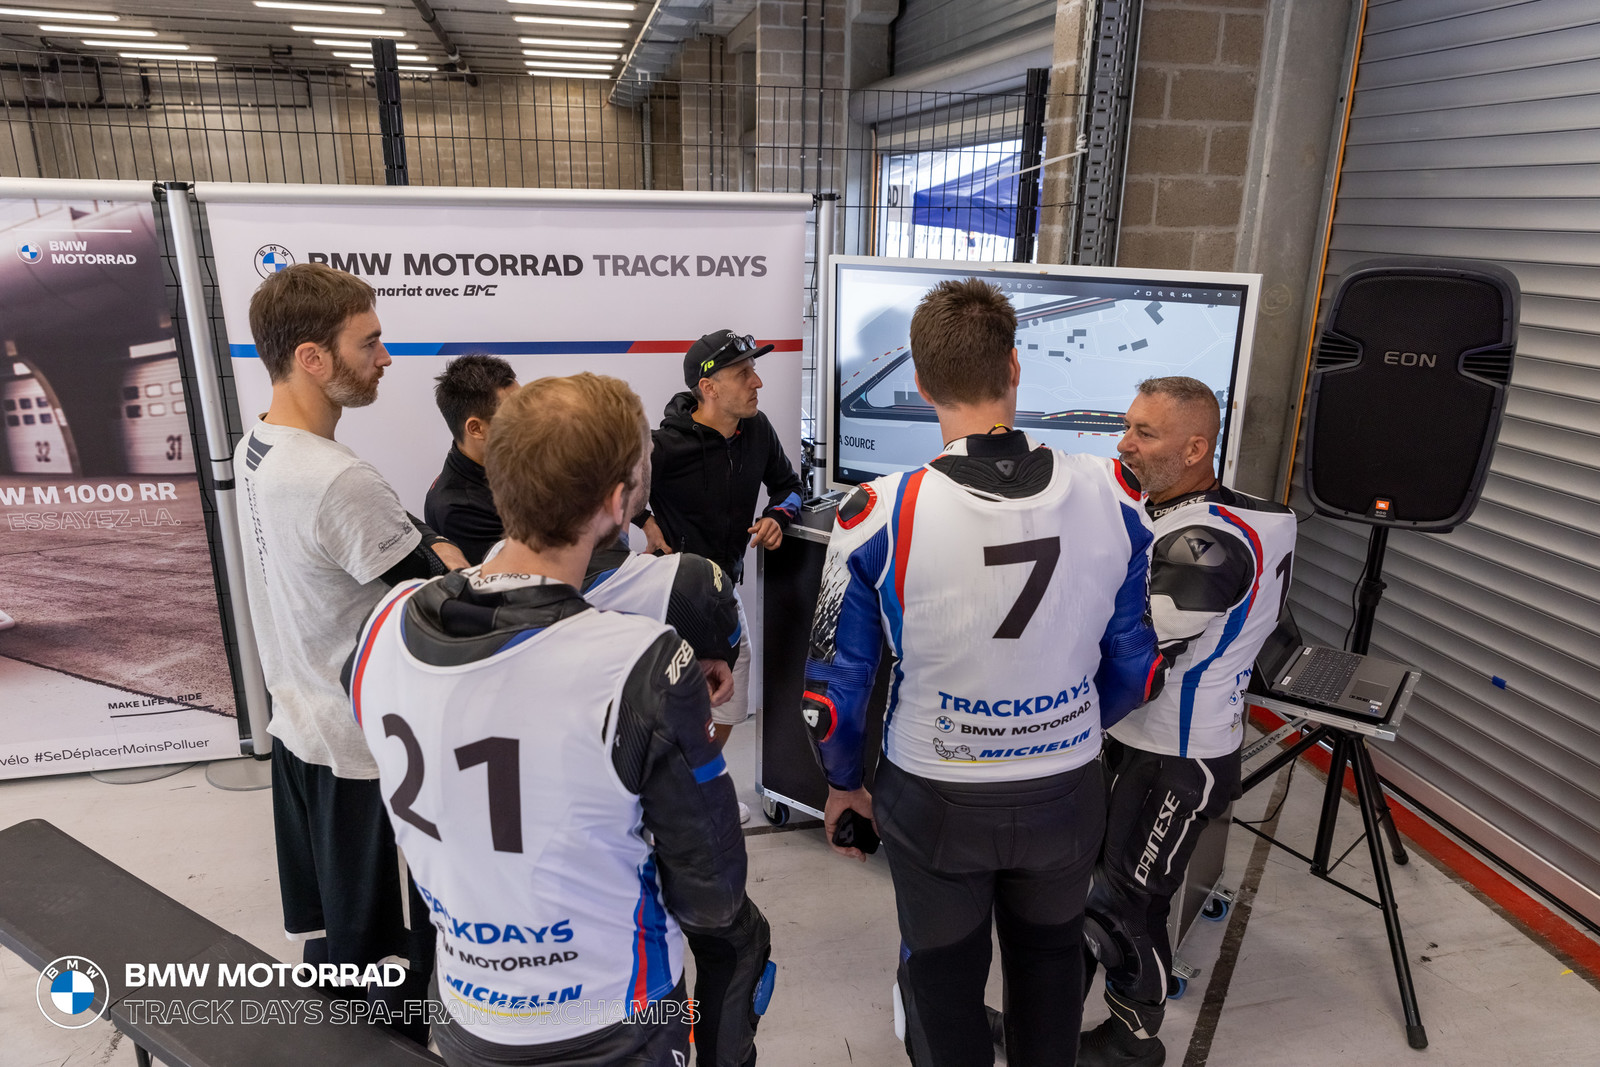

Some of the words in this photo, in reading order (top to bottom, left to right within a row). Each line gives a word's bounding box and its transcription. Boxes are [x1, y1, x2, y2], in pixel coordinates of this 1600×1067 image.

[49, 240, 87, 252] BMW
[51, 253, 137, 265] MOTORRAD
[403, 253, 584, 276] MOTORRAD
[592, 254, 690, 277] TRACK
[696, 255, 768, 278] DAYS
[375, 284, 422, 297] enariat
[425, 287, 459, 297] avec
[463, 284, 498, 297] BMC
[1383, 351, 1437, 368] EON
[35, 440, 51, 463] 32
[166, 434, 182, 461] 31
[844, 435, 876, 451] SOURCE
[32, 486, 61, 505] M
[64, 483, 134, 504] 1000
[139, 482, 178, 501] RR
[7, 507, 182, 531] ESSAYEZ-LA.
[983, 536, 1061, 639] 7
[108, 701, 140, 710] MAKE
[142, 699, 165, 708] LIFE
[177, 692, 203, 703] RIDE
[938, 674, 1090, 717] TRACKDAYS
[960, 724, 1007, 736] BMW
[1011, 700, 1092, 736] MOTORRAD
[0, 753, 29, 767] vélo
[34, 738, 210, 764] #SeDéplacerMoinsPolluer
[978, 727, 1092, 758] MICHELIN
[382, 713, 523, 854] 21
[458, 951, 579, 971] MOTORRAD
[446, 974, 583, 1009] MICHELIN
